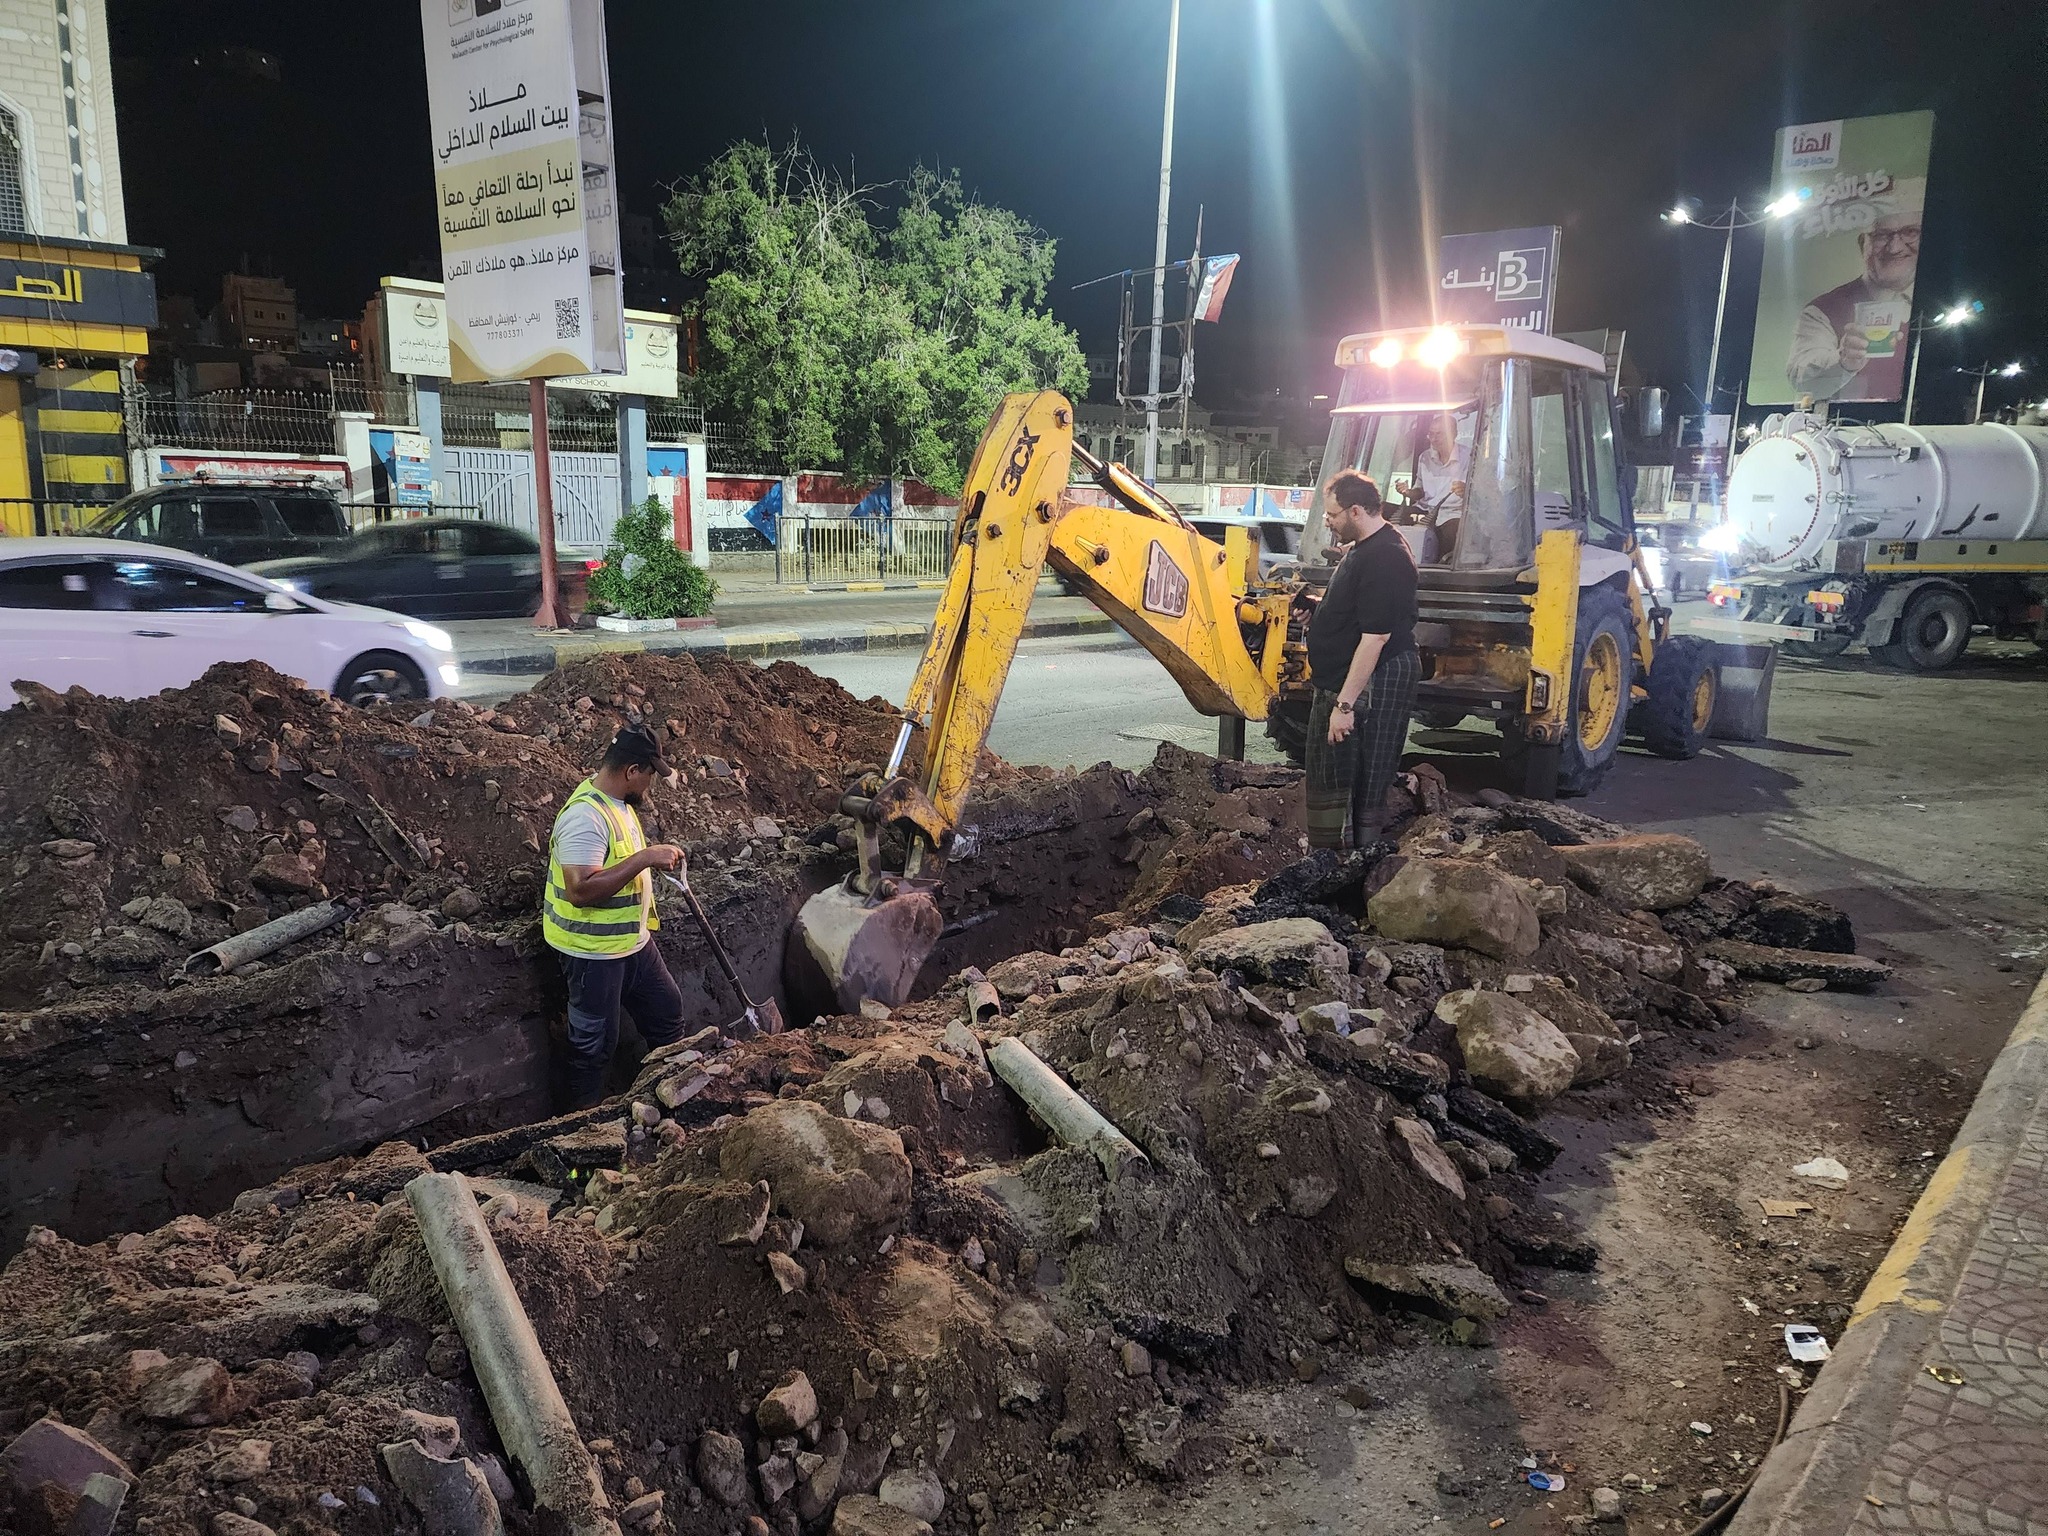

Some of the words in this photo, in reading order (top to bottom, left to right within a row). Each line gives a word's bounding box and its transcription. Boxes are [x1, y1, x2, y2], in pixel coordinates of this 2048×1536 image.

[476, 20, 501, 39] للسلامة
[502, 17, 516, 30] ملاذ
[517, 12, 533, 28] مركز
[450, 30, 475, 49] النفسية
[519, 27, 535, 39] Safety
[469, 83, 527, 113] ملاذ
[489, 108, 536, 150] السلام
[541, 105, 569, 130] بيت
[438, 121, 484, 164] الداخلي
[516, 171, 543, 193] رحلة
[547, 159, 573, 187] نبدأ
[442, 183, 464, 207] معاً
[468, 175, 511, 211] التعافي
[552, 192, 576, 218] نحو
[444, 208, 491, 237] النفسية
[495, 197, 546, 224] السلامة
[475, 258, 506, 274] ملاذك
[557, 246, 579, 265] مركز
[447, 260, 472, 281] الآمن
[1441, 266, 1496, 292] بنك
[0, 268, 83, 303] الص
[494, 313, 518, 327] كورنيش
[524, 312, 541, 326] ريمي
[487, 328, 524, 340] 777803371
[574, 377, 611, 388] SCHOOL
[1000, 424, 1041, 497] 3CX
[1149, 550, 1187, 613] JCB
